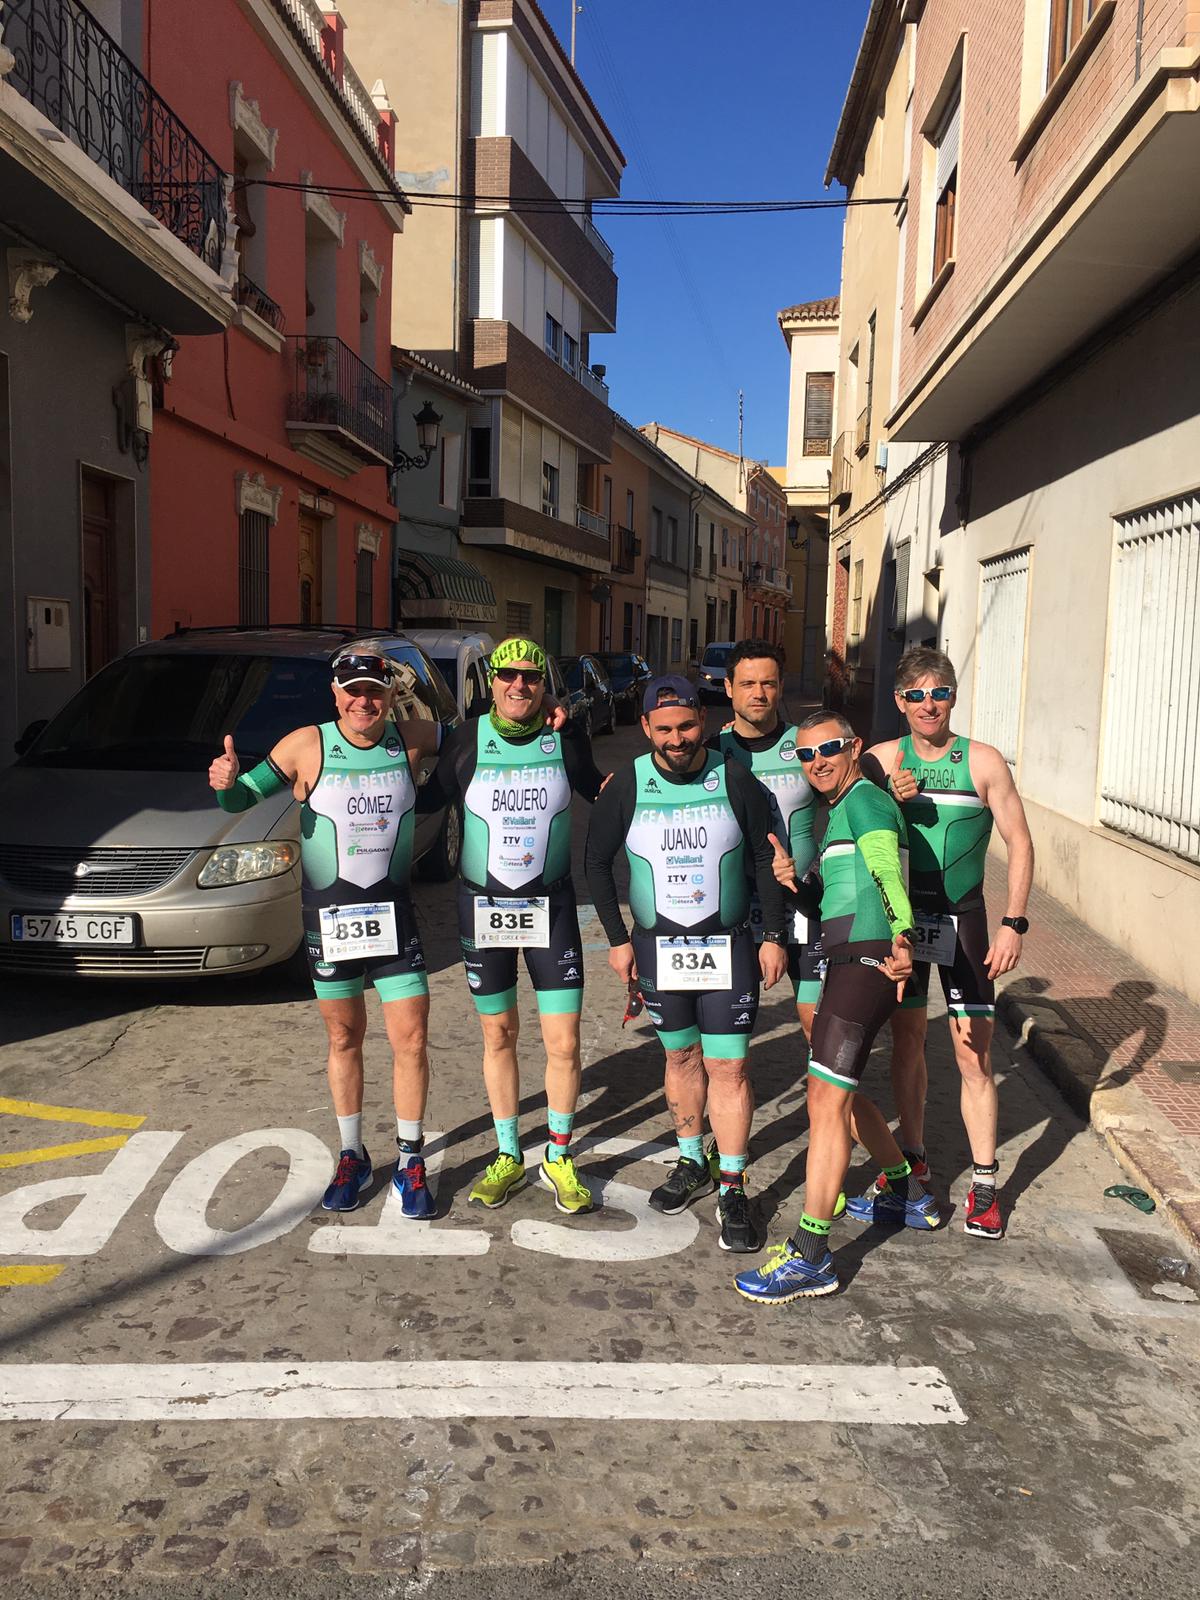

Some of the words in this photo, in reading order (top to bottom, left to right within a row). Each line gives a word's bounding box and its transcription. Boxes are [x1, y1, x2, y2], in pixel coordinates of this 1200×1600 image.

[323, 773, 352, 788] CEA
[358, 769, 410, 789] BÉTERA
[480, 768, 505, 784] CEA
[510, 765, 563, 784] BÉTERA
[347, 792, 393, 815] GÓMEZ
[491, 787, 548, 812] BAQUERO
[640, 809, 667, 823] CEA
[672, 804, 729, 823] BÉTERA
[503, 836, 520, 844] ITV
[661, 826, 708, 851] JUANJO
[674, 854, 704, 864] Vaillant
[667, 874, 687, 883] ITV
[27, 919, 78, 939] 5745
[87, 919, 126, 940] CGF
[335, 919, 382, 941] 83B
[489, 912, 534, 929] 83E
[915, 927, 941, 945] 3F
[671, 952, 717, 970] 83A
